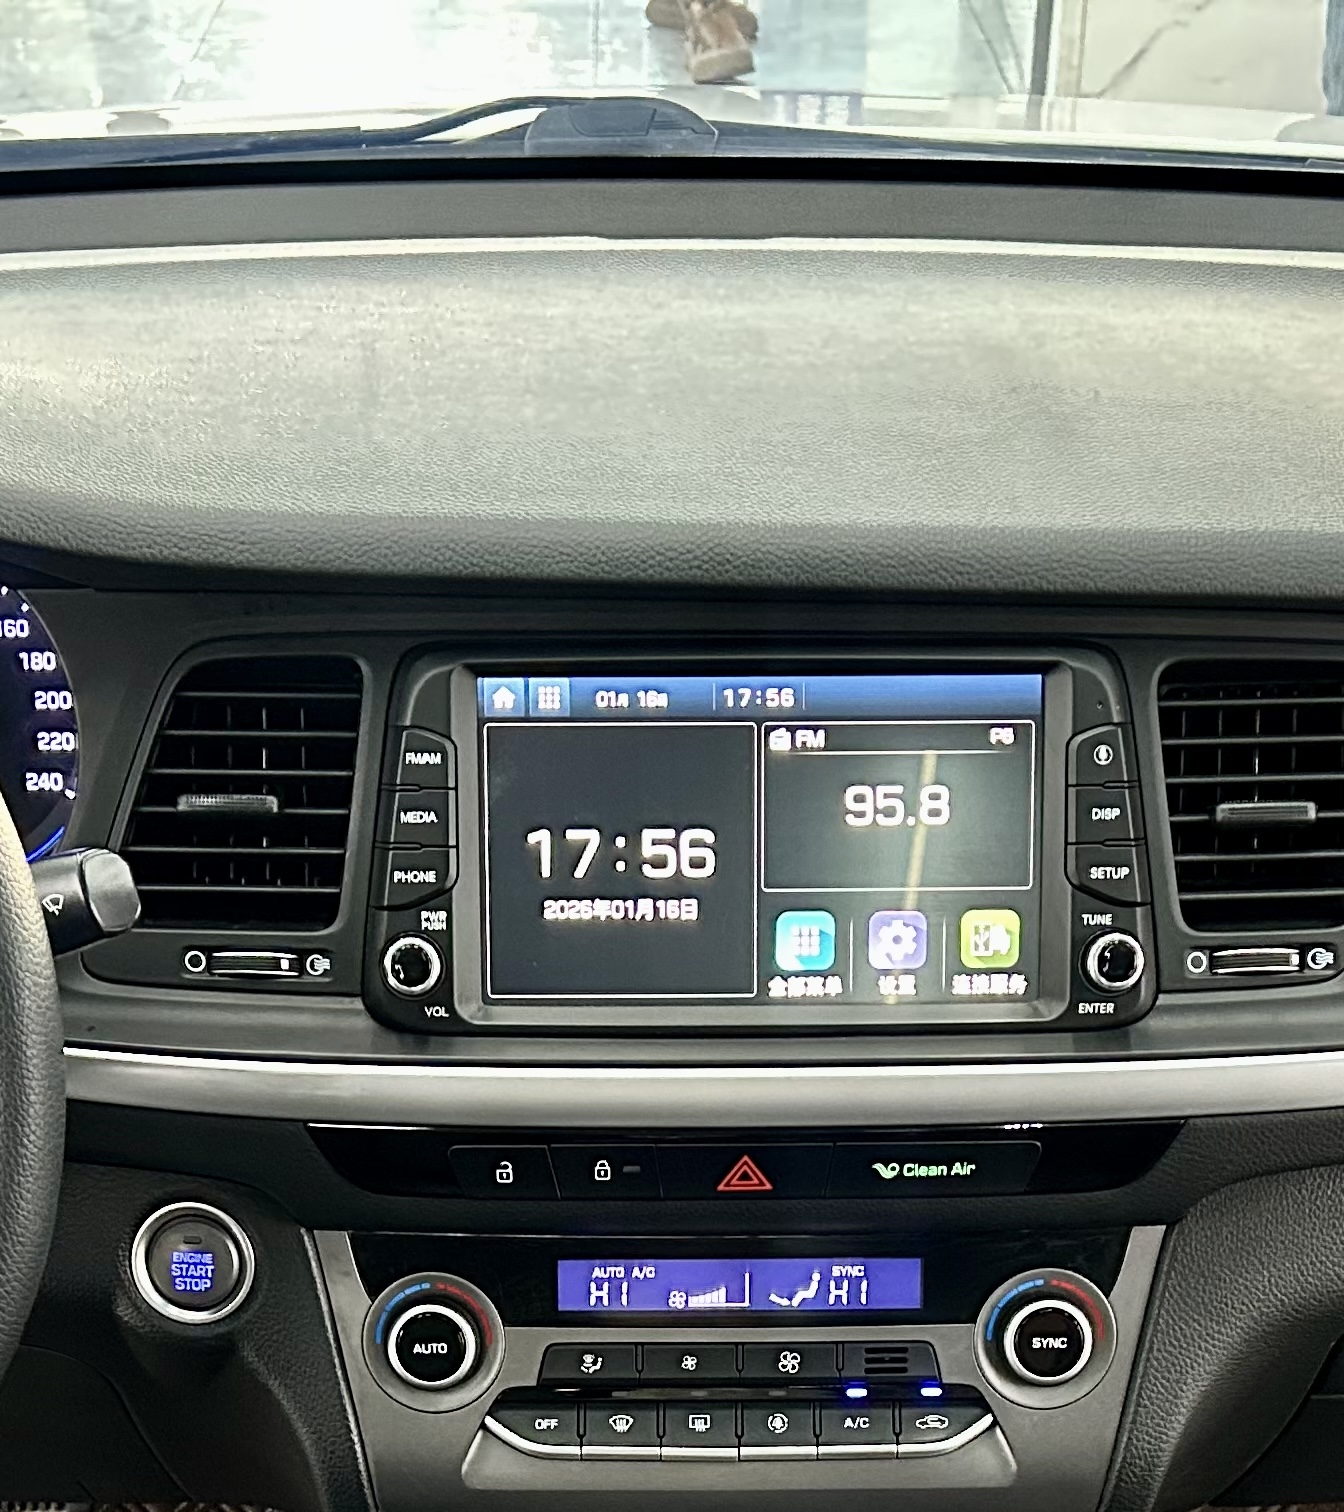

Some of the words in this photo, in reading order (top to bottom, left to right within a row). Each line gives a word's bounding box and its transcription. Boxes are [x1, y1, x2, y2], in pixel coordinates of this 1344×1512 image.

[18, 650, 57, 672] 180
[34, 690, 74, 711] 200
[723, 687, 795, 708] 17:56
[36, 731, 76, 752] 220
[795, 729, 826, 750] FM
[25, 772, 64, 792] 240
[843, 783, 951, 829] 95.8
[399, 810, 439, 824] MEDIA
[1091, 807, 1121, 821] DISP
[526, 828, 716, 879] 17:56
[393, 869, 437, 884] PHONE
[1089, 866, 1130, 880] SETUP
[543, 897, 699, 922] 2026年01月16日
[1081, 913, 1113, 926] TUNE
[424, 1005, 450, 1018] VOL
[1077, 1002, 1115, 1014] ENTER
[902, 1163, 948, 1178] Clean
[950, 1161, 976, 1176] Air
[172, 1251, 214, 1264] ENGINE
[171, 1263, 215, 1278] START
[591, 1266, 625, 1279] AUTO
[631, 1265, 656, 1279] A/C
[831, 1265, 865, 1278] SYNC
[174, 1277, 212, 1292] STOP
[412, 1342, 448, 1355] AUTO
[1031, 1337, 1068, 1349] SYNC
[534, 1418, 559, 1430] OFF
[843, 1416, 870, 1429] A/C
